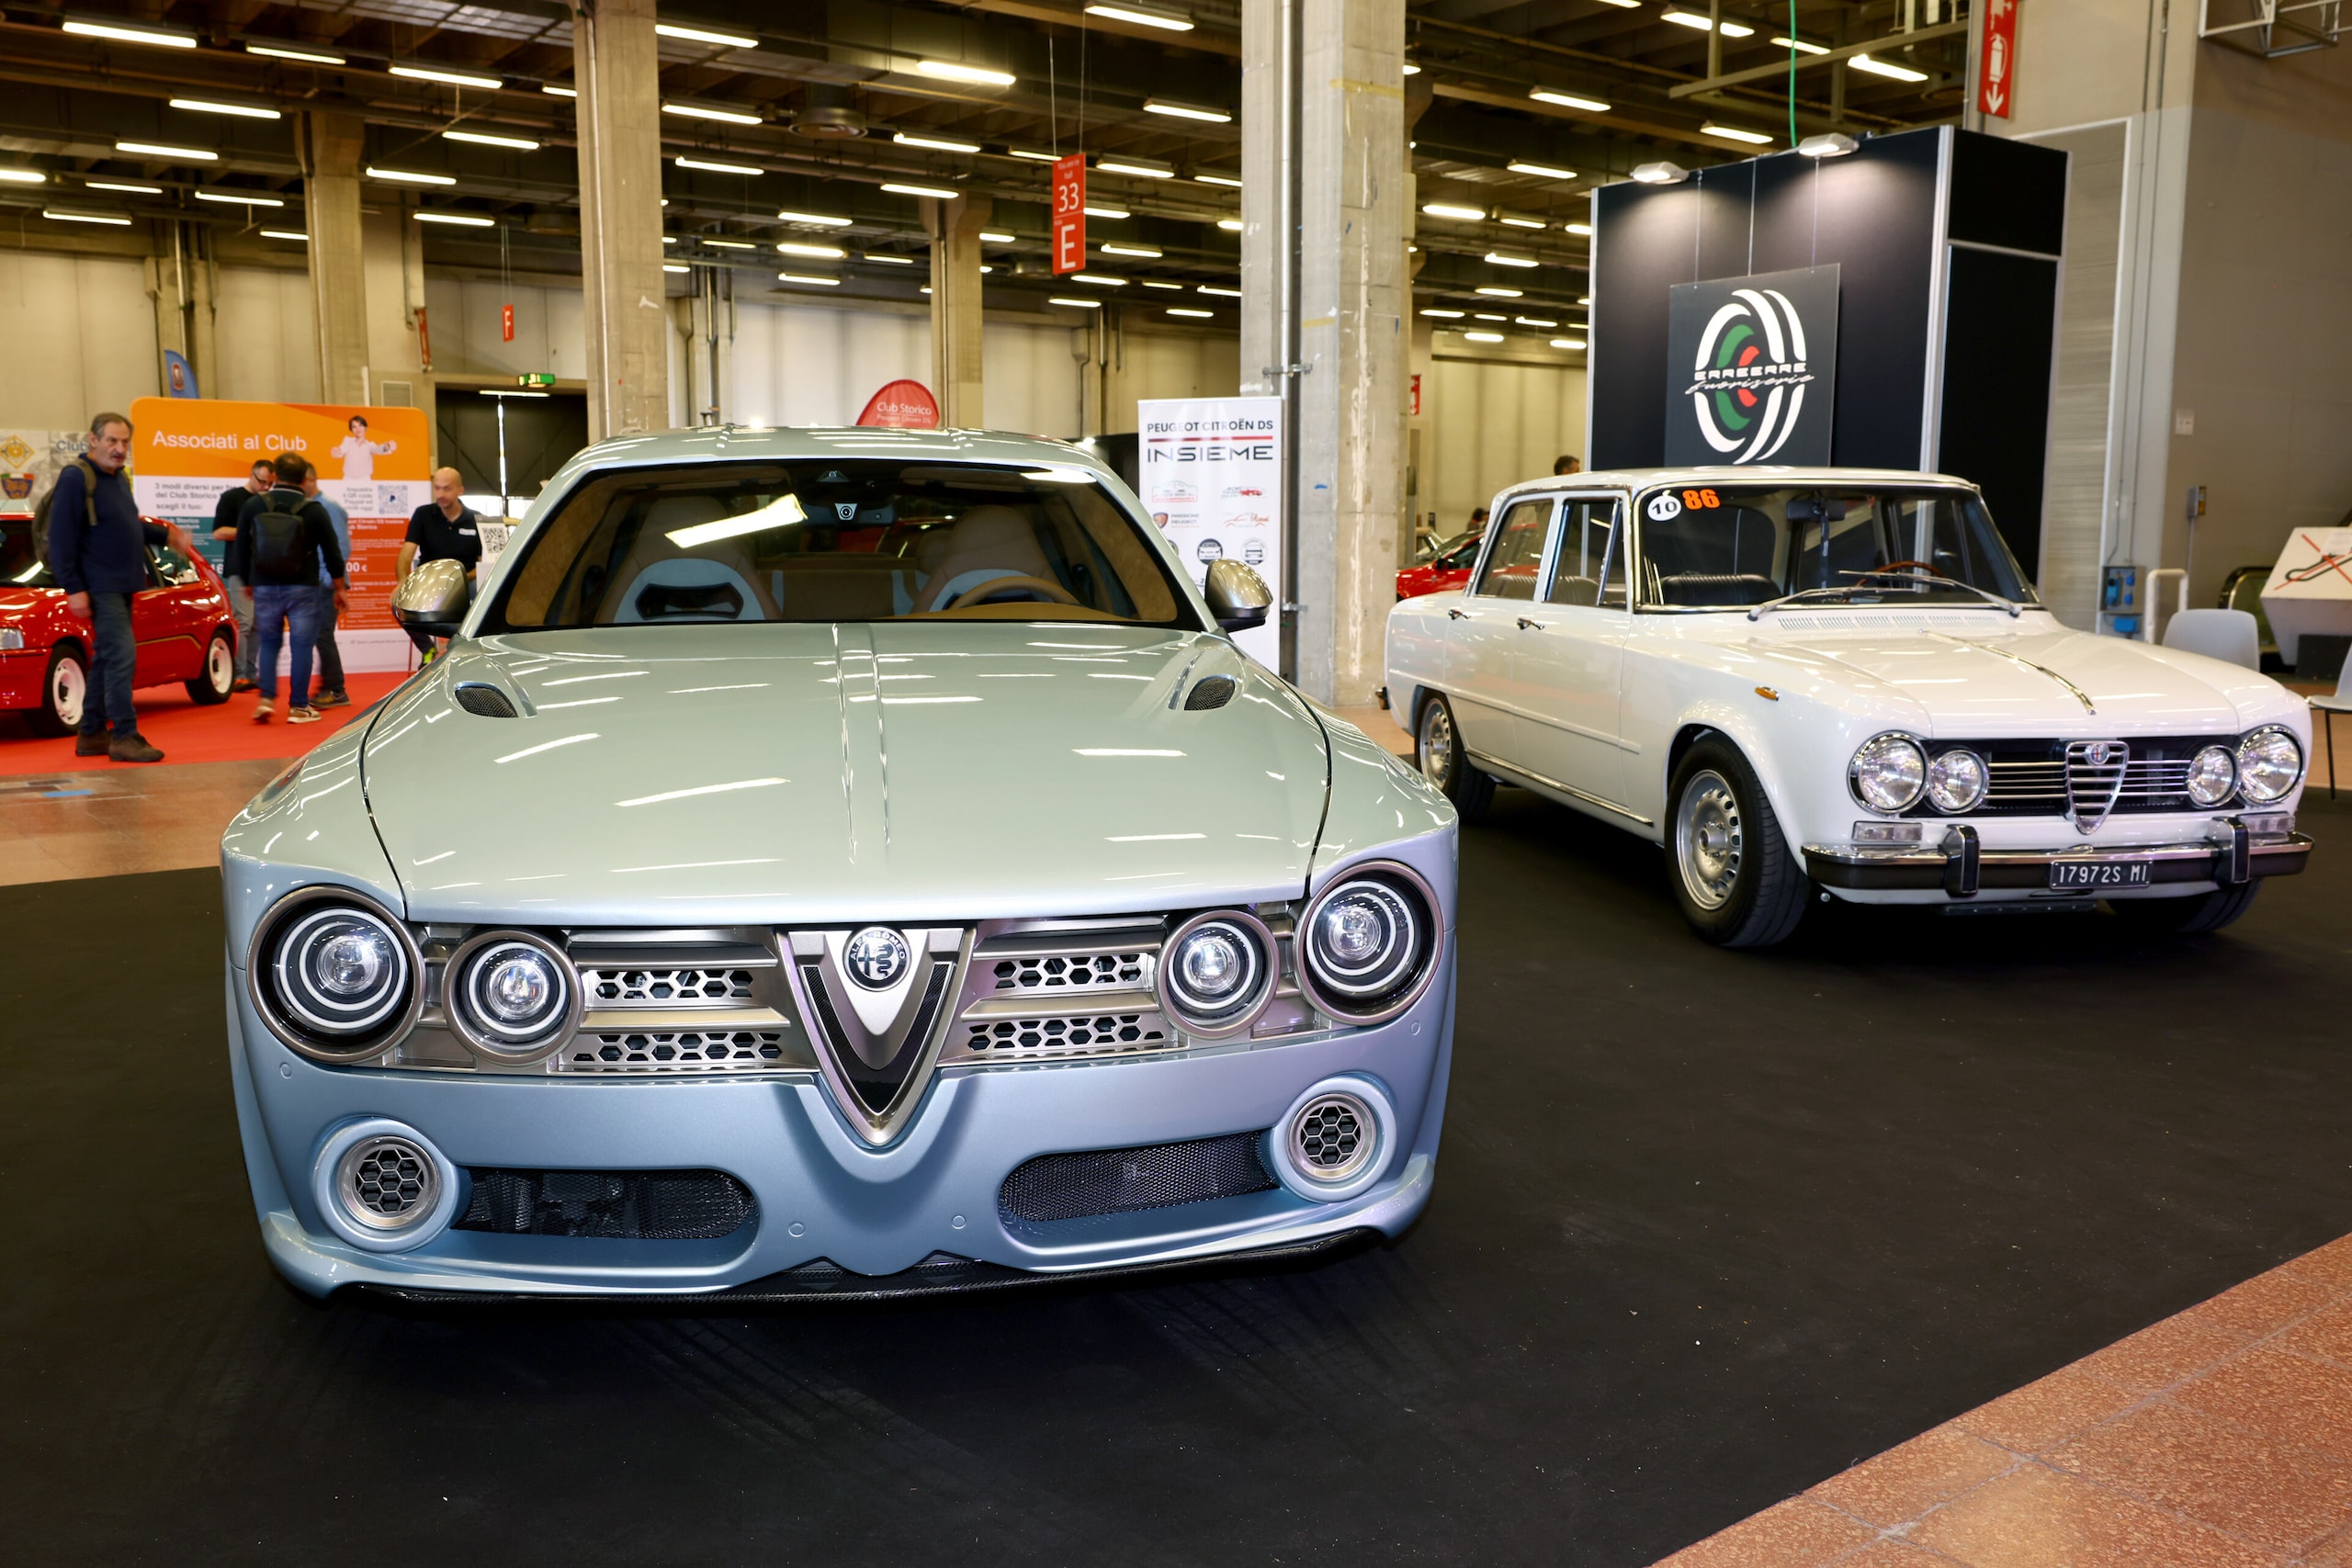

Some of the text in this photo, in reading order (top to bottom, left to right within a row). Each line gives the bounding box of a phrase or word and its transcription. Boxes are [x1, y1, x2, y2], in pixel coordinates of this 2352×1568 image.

[1058, 182, 1080, 212] 33
[1060, 223, 1076, 270] E
[1694, 363, 1806, 381] ERREERRE
[876, 401, 933, 415] Club Storico
[1148, 418, 1273, 433] PEUGEOT CITROËN DS
[153, 430, 307, 451] Associati al Club
[1148, 446, 1273, 462] INSIEME
[1652, 501, 1678, 515] 10
[1682, 489, 1721, 510] 86
[2059, 864, 2147, 884] 17972S MI
[874, 931, 906, 960] ROMEO
